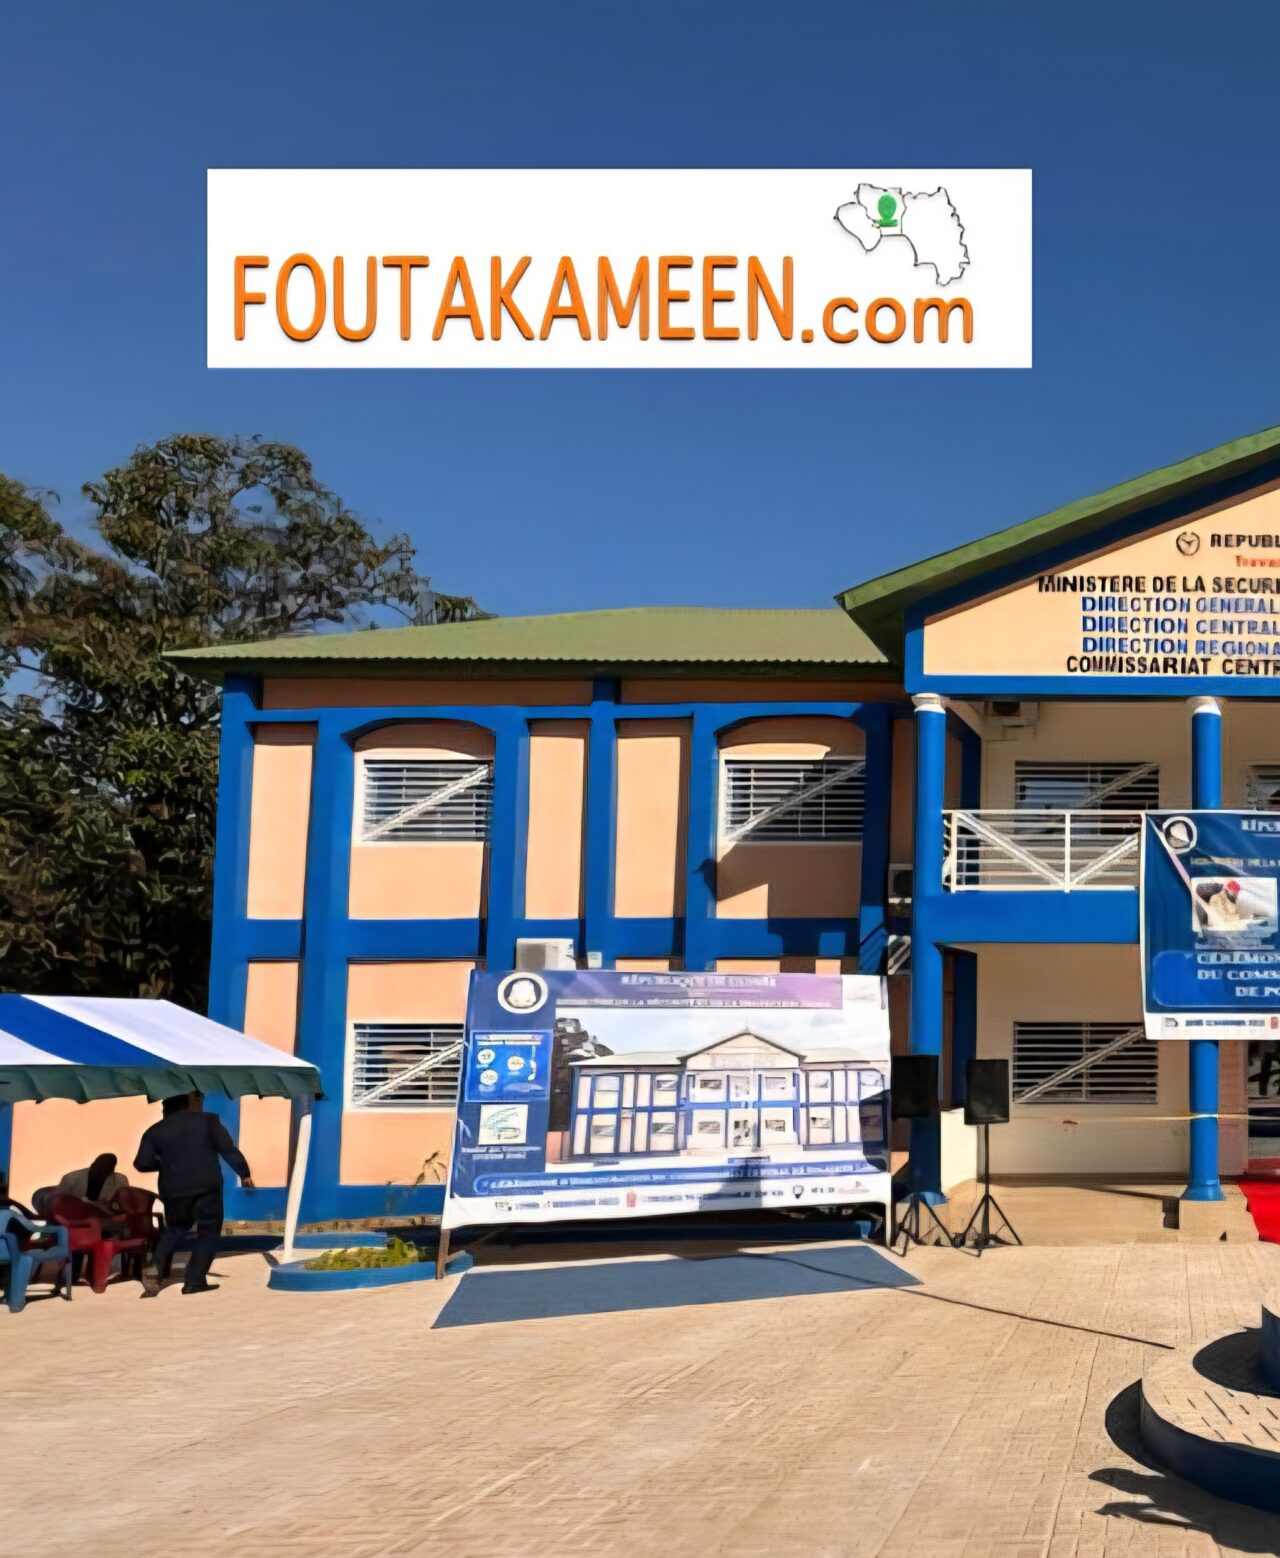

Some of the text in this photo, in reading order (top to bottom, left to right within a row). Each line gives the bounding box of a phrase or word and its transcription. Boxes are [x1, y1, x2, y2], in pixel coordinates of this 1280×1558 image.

[1038, 575, 1146, 593] MINISTERE
[1152, 576, 1177, 593] DE
[1182, 577, 1206, 593] LA
[1081, 596, 1190, 613] DIRECTION
[1082, 616, 1188, 634] DIRECTION
[1082, 637, 1188, 654] DIRECTION
[1066, 655, 1211, 675] COMMISSARIAT
